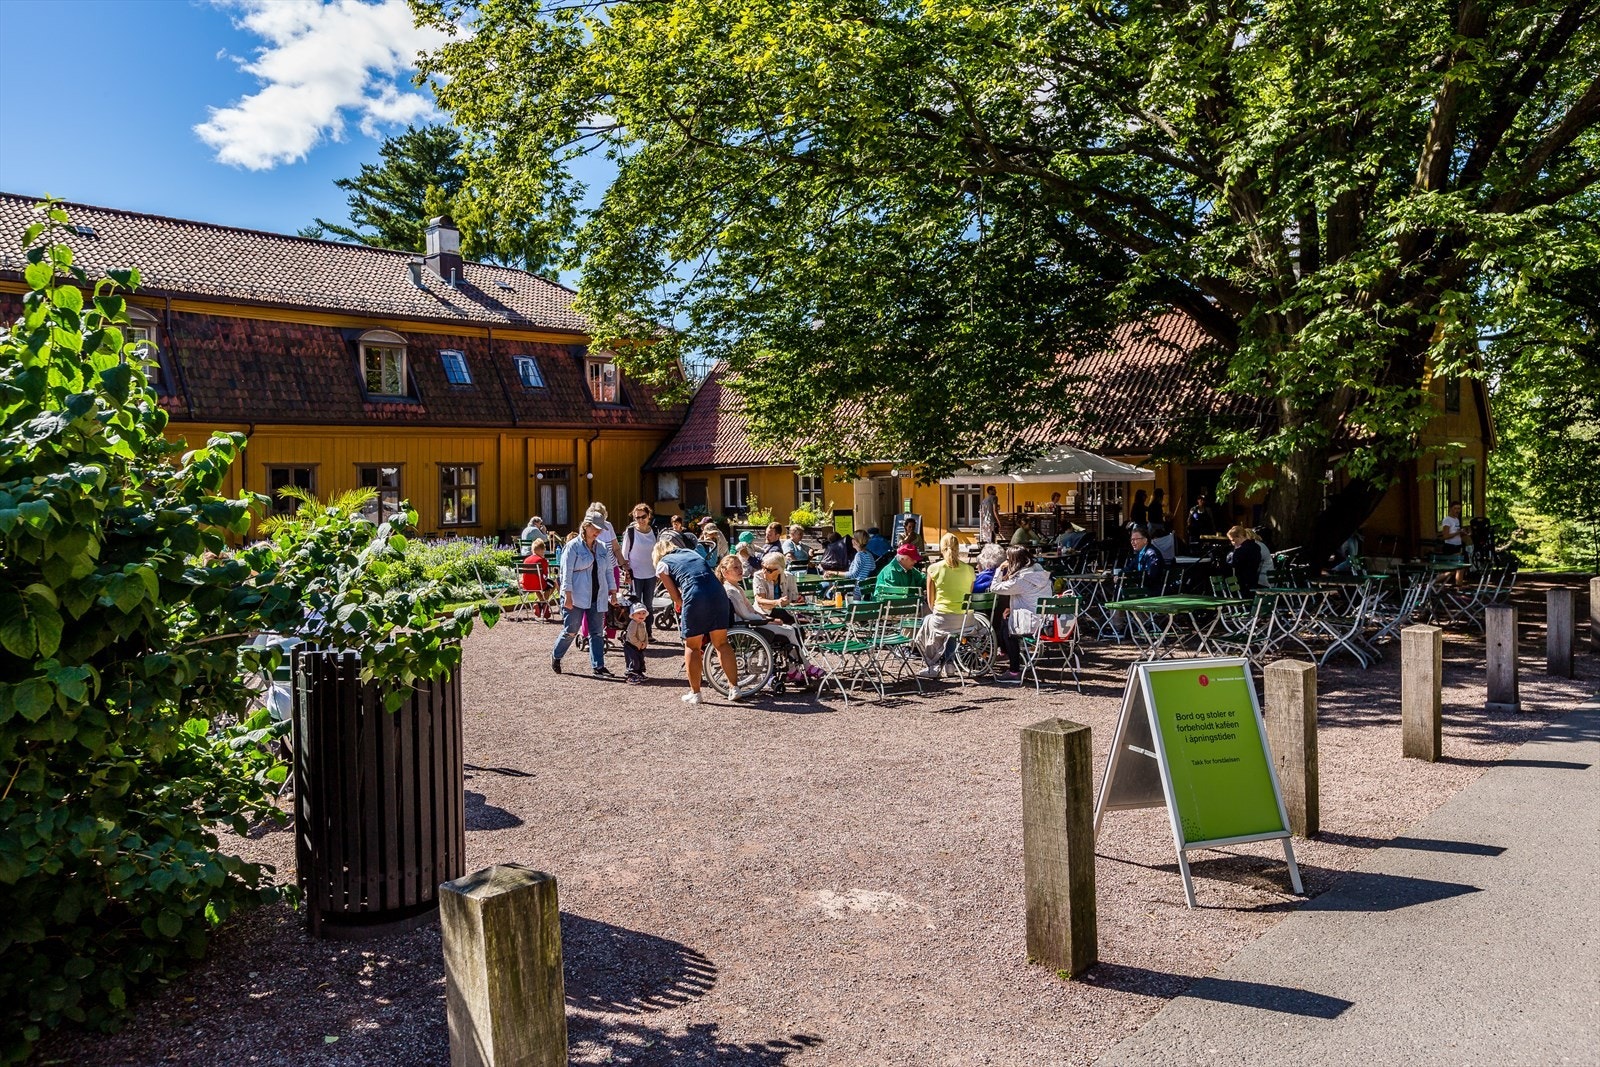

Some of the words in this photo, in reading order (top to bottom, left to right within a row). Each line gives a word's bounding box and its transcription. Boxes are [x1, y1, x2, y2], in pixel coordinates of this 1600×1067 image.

[1176, 712, 1193, 721] Bord
[1195, 713, 1205, 721] og
[1207, 711, 1227, 719] stoler
[1176, 722, 1214, 732] forbeholdt
[1215, 721, 1239, 730] kaféen
[1189, 733, 1236, 744] åpningstiden
[1212, 756, 1240, 765] forståelsen
